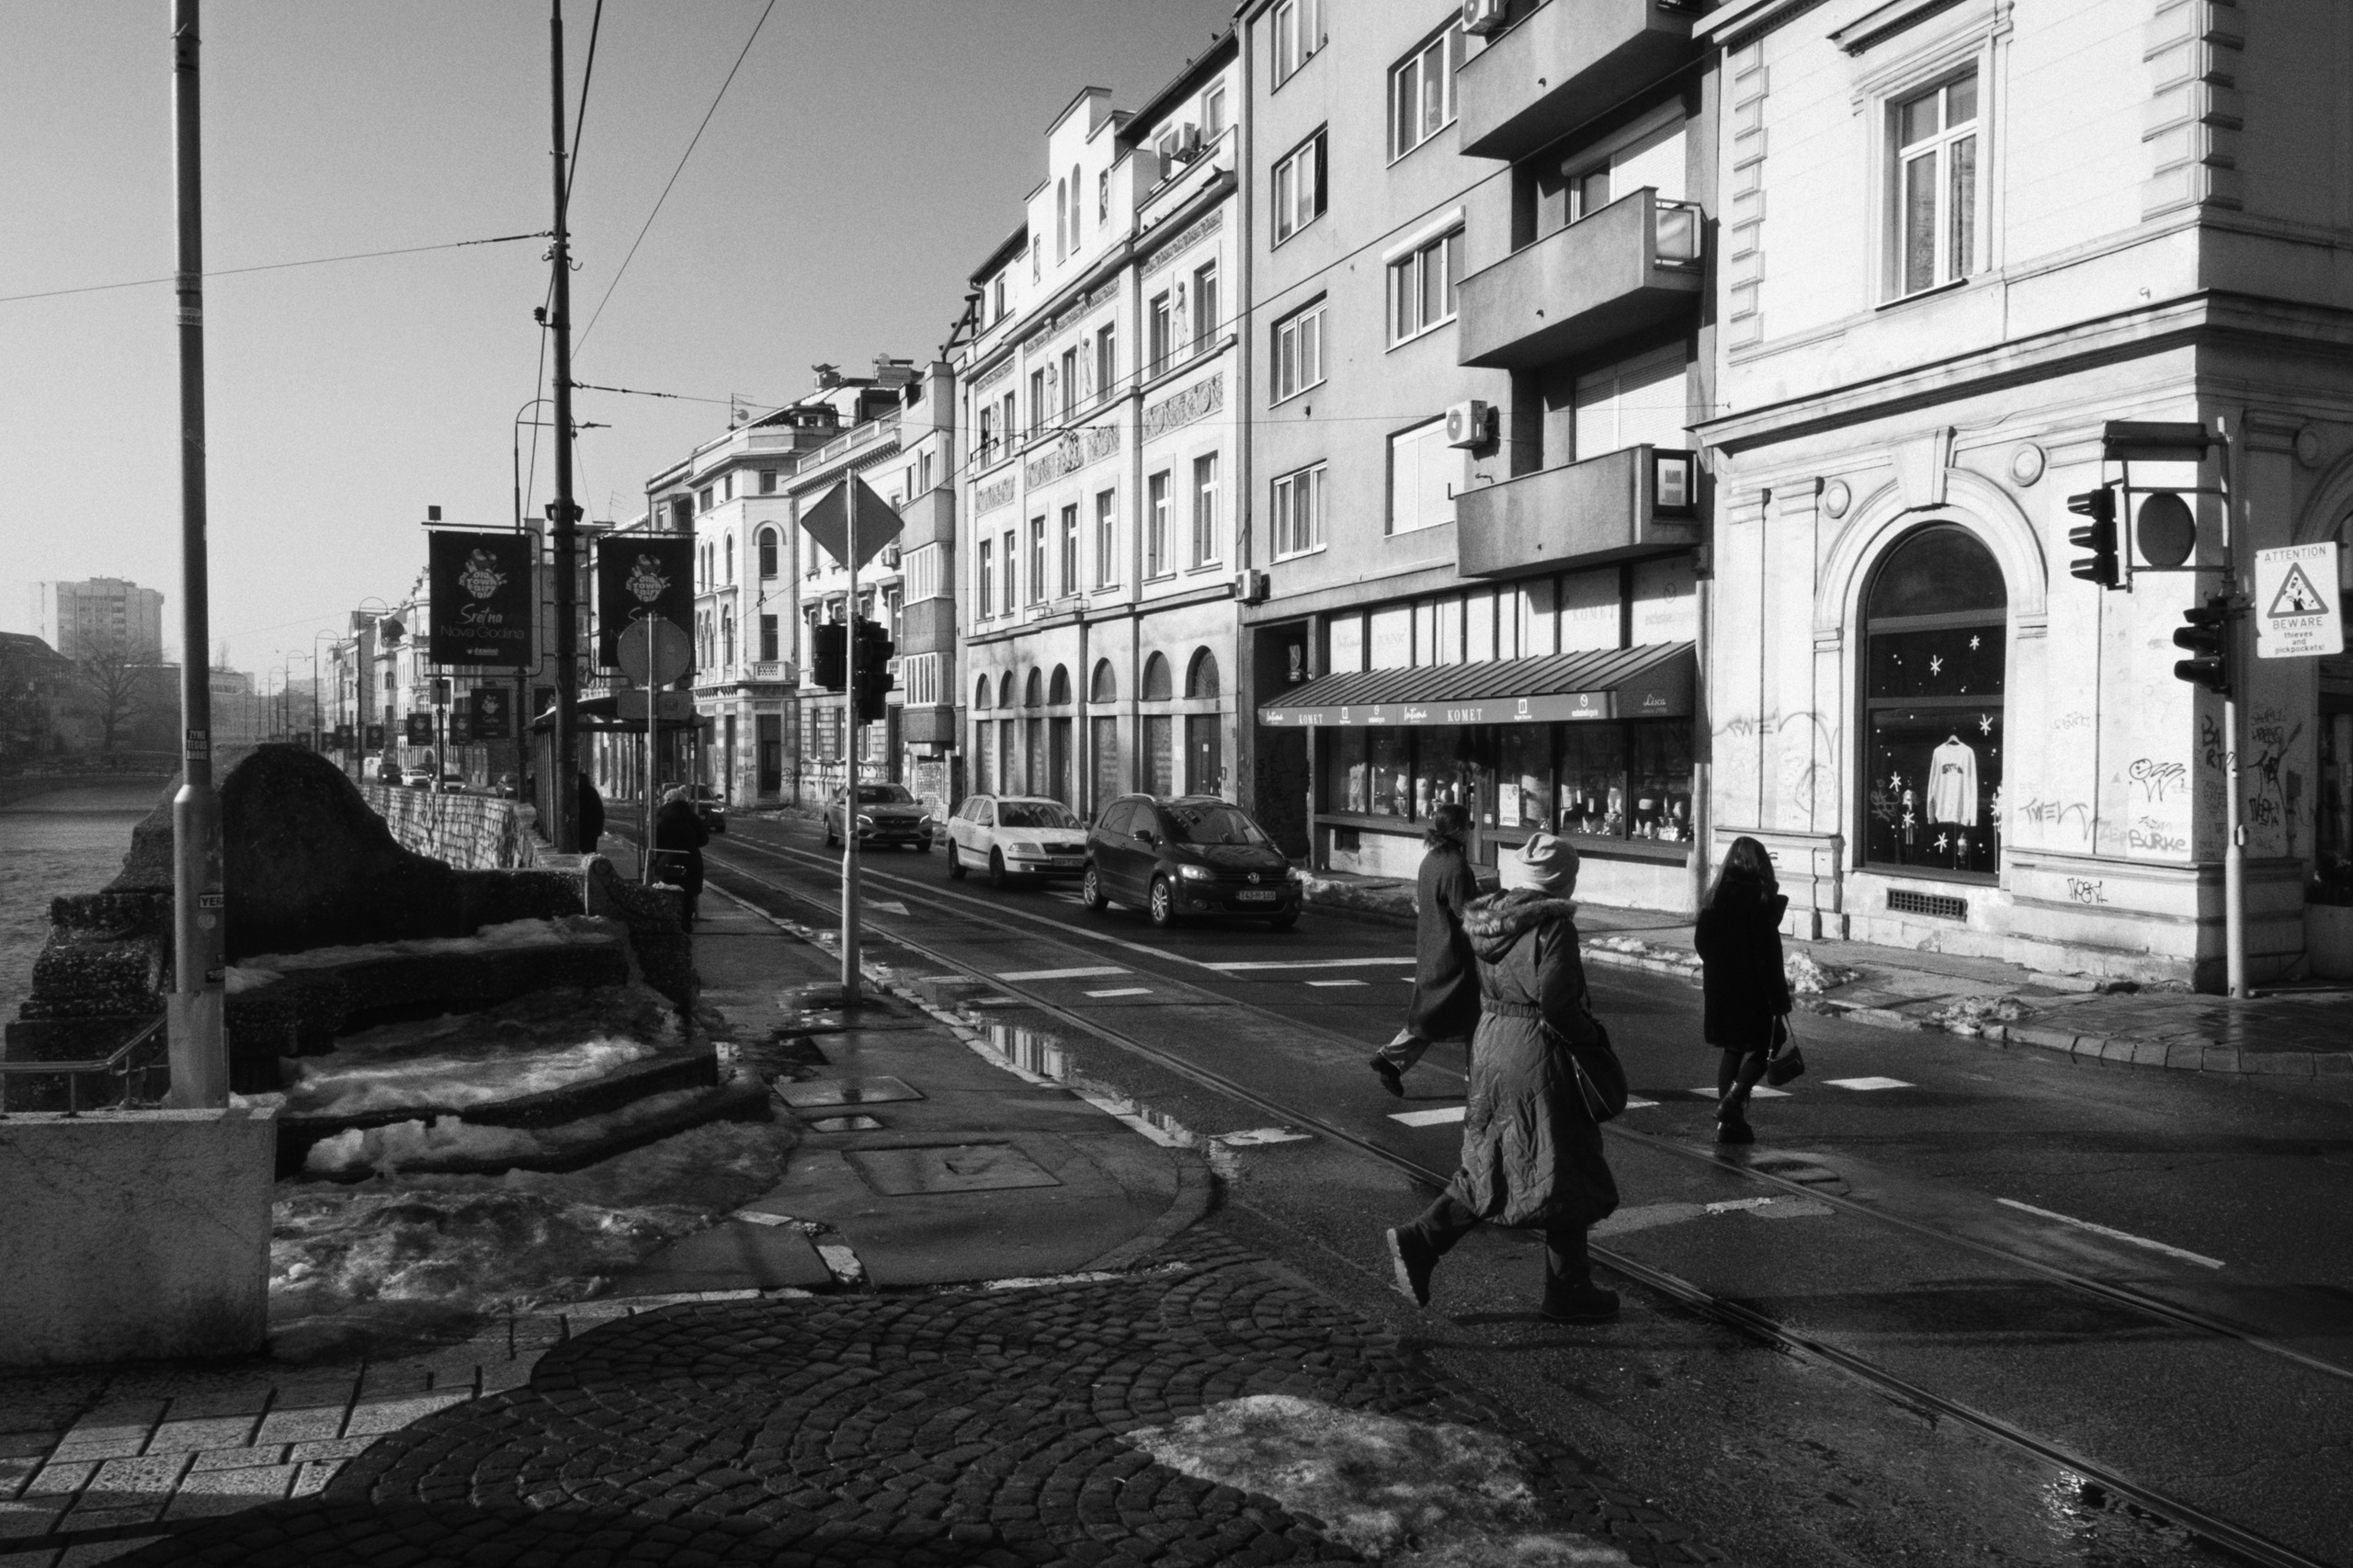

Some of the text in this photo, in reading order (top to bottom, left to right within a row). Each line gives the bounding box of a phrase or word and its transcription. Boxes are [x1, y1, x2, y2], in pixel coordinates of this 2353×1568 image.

[2265, 545, 2327, 562] ATTENTION
[456, 603, 504, 625] Sretna
[2272, 617, 2324, 630] BEWARE
[440, 625, 525, 640] Nova Godina
[1298, 713, 1324, 724] KOMET
[1447, 708, 1483, 722] KOMET
